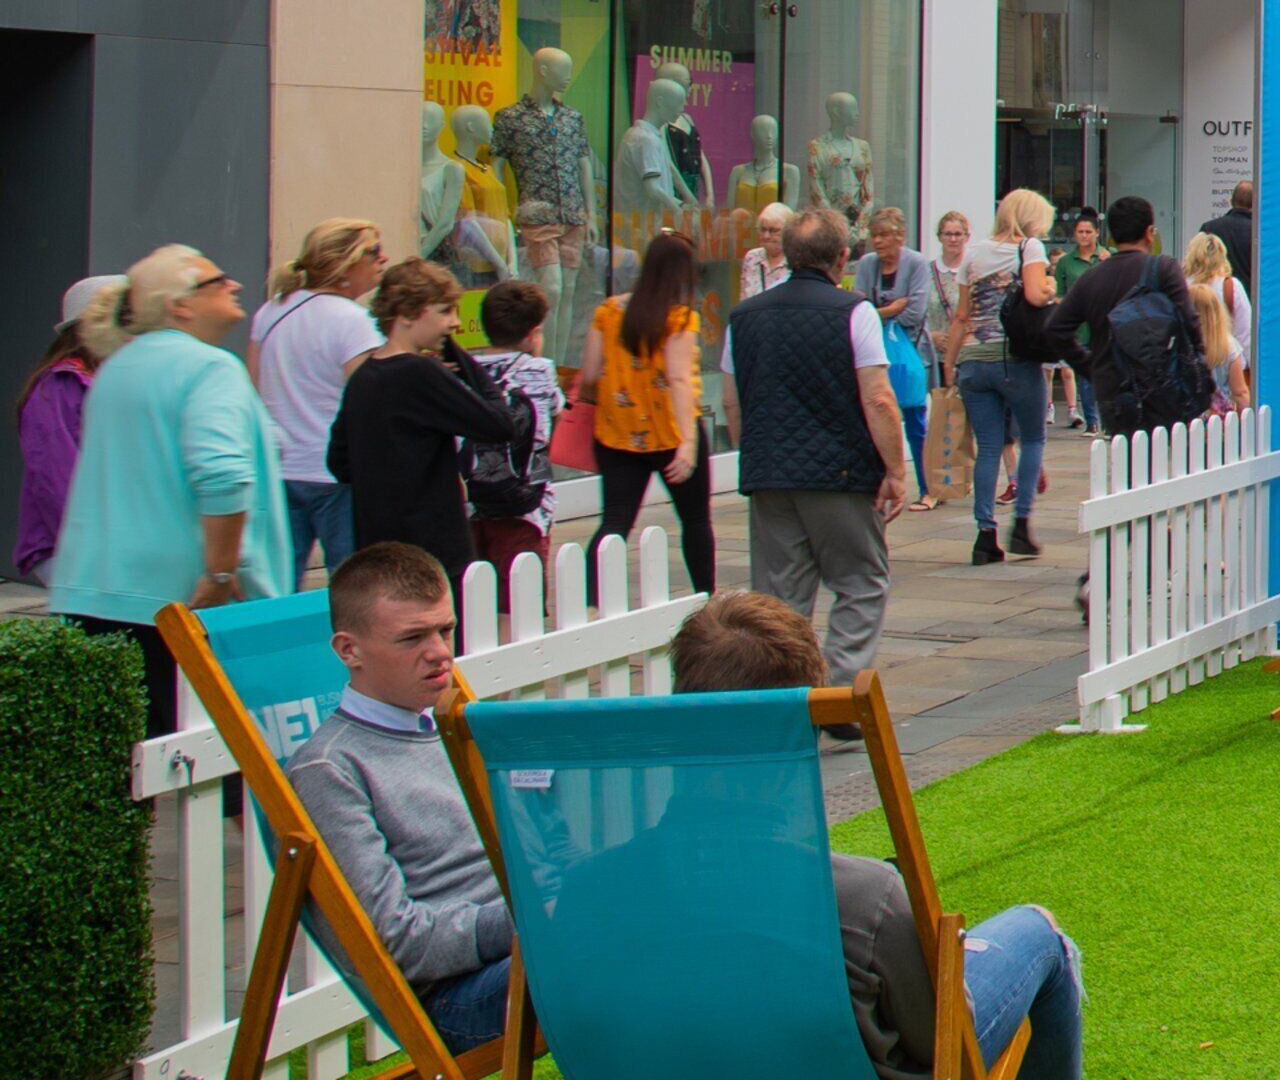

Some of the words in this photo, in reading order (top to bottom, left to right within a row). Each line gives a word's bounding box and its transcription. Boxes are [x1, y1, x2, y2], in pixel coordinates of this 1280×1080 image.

[424, 37, 502, 67] STIVAL
[650, 45, 733, 73] SUMMER
[425, 79, 494, 107] ELING
[1203, 120, 1253, 136] OUTF
[613, 205, 751, 262] SUMME
